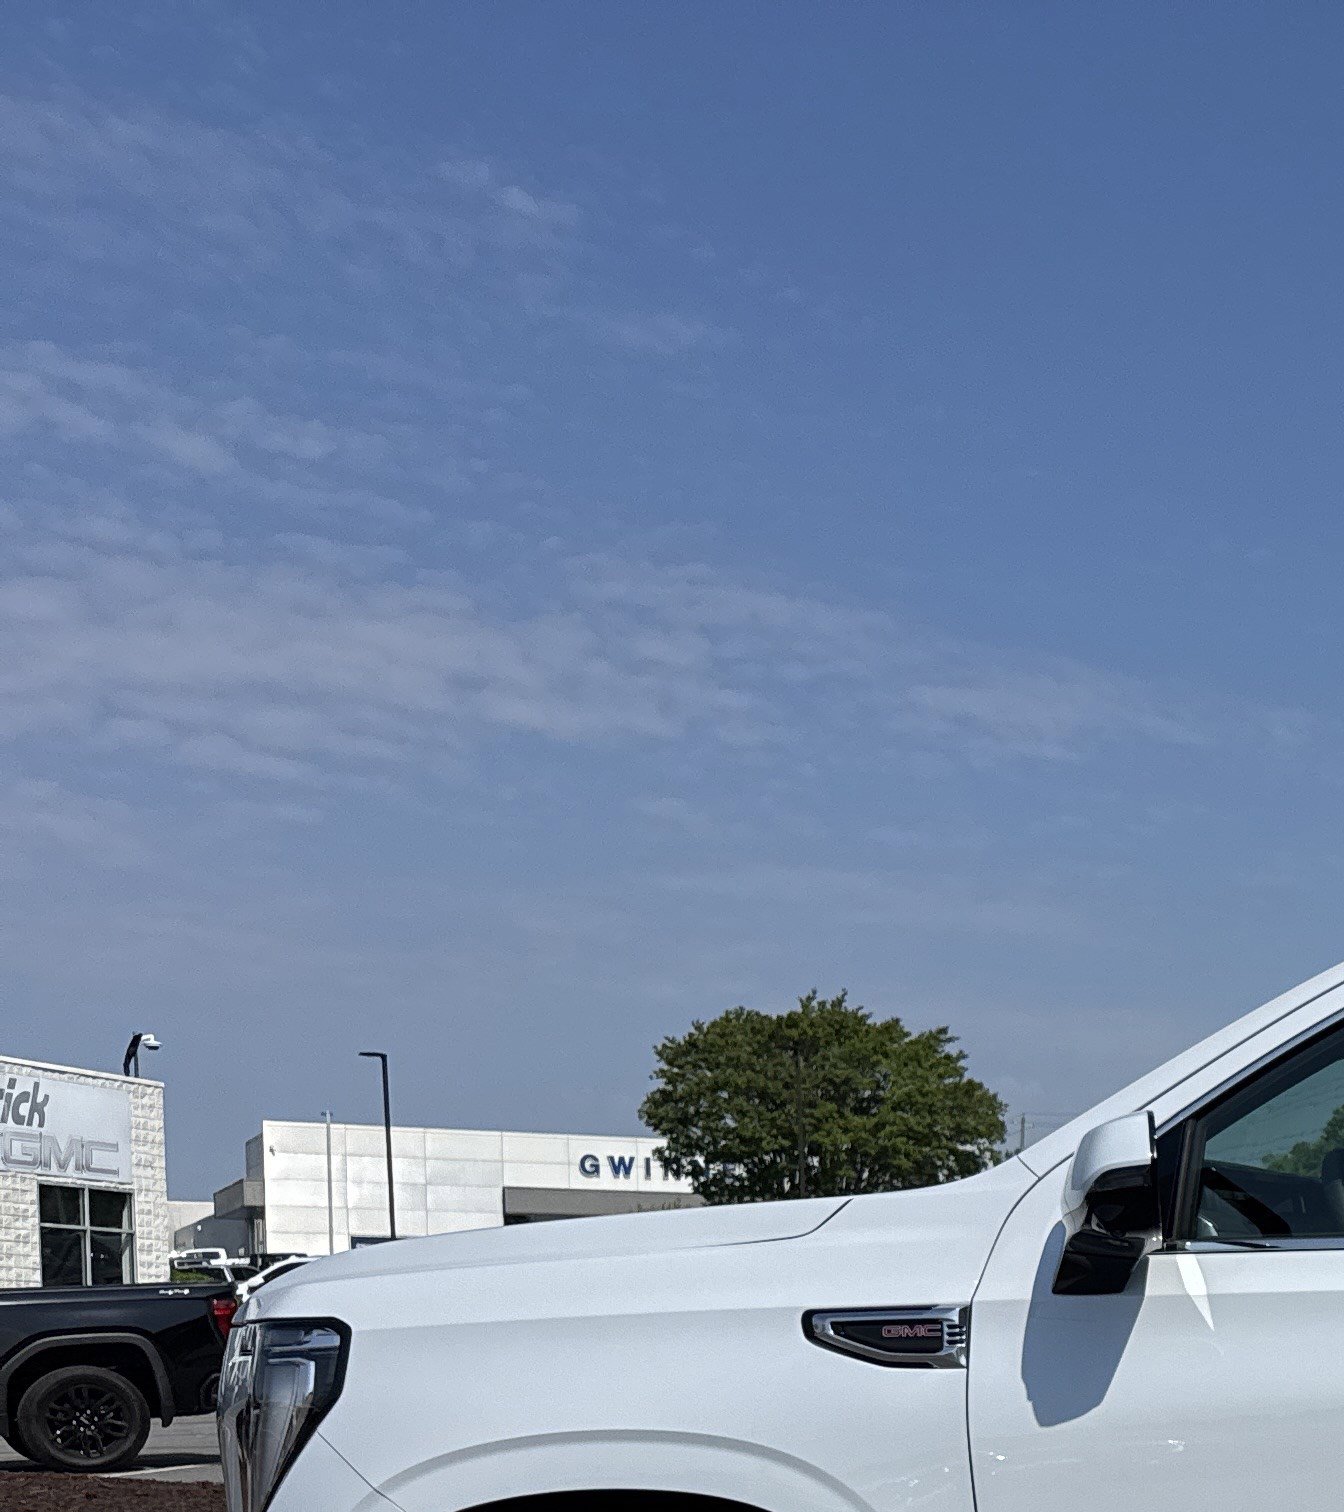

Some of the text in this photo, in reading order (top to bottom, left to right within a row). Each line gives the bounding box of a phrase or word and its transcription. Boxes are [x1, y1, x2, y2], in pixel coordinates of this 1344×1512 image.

[0, 1077, 49, 1128] ick
[2, 1131, 120, 1178] GMC
[579, 1154, 736, 1182] GWIN
[882, 1323, 942, 1338] GMC
